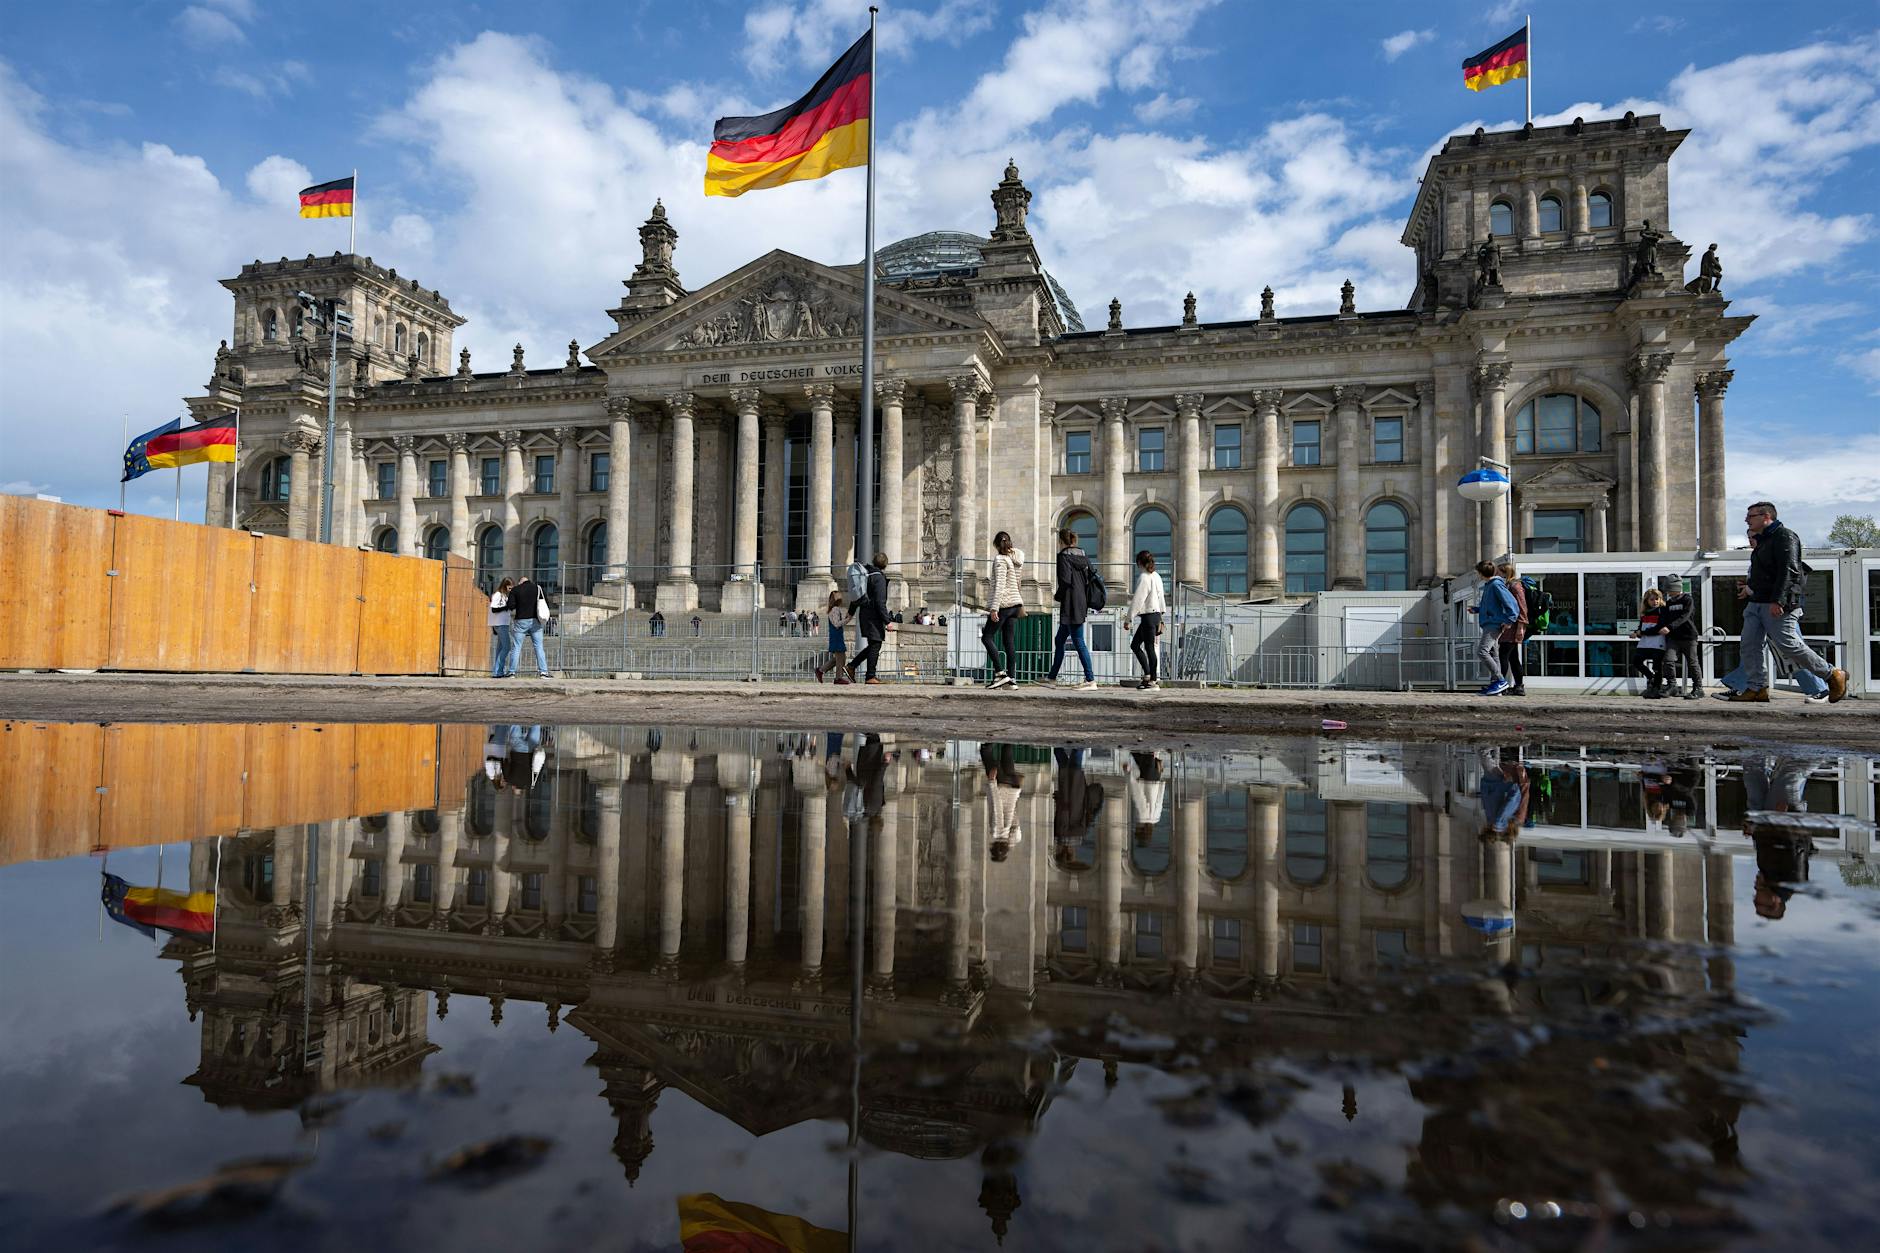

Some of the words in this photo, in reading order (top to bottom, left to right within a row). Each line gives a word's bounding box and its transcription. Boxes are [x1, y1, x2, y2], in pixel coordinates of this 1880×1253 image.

[702, 373, 730, 384] DEM
[741, 367, 814, 381] DEUTSCHEN
[825, 364, 864, 376] VOLKE
